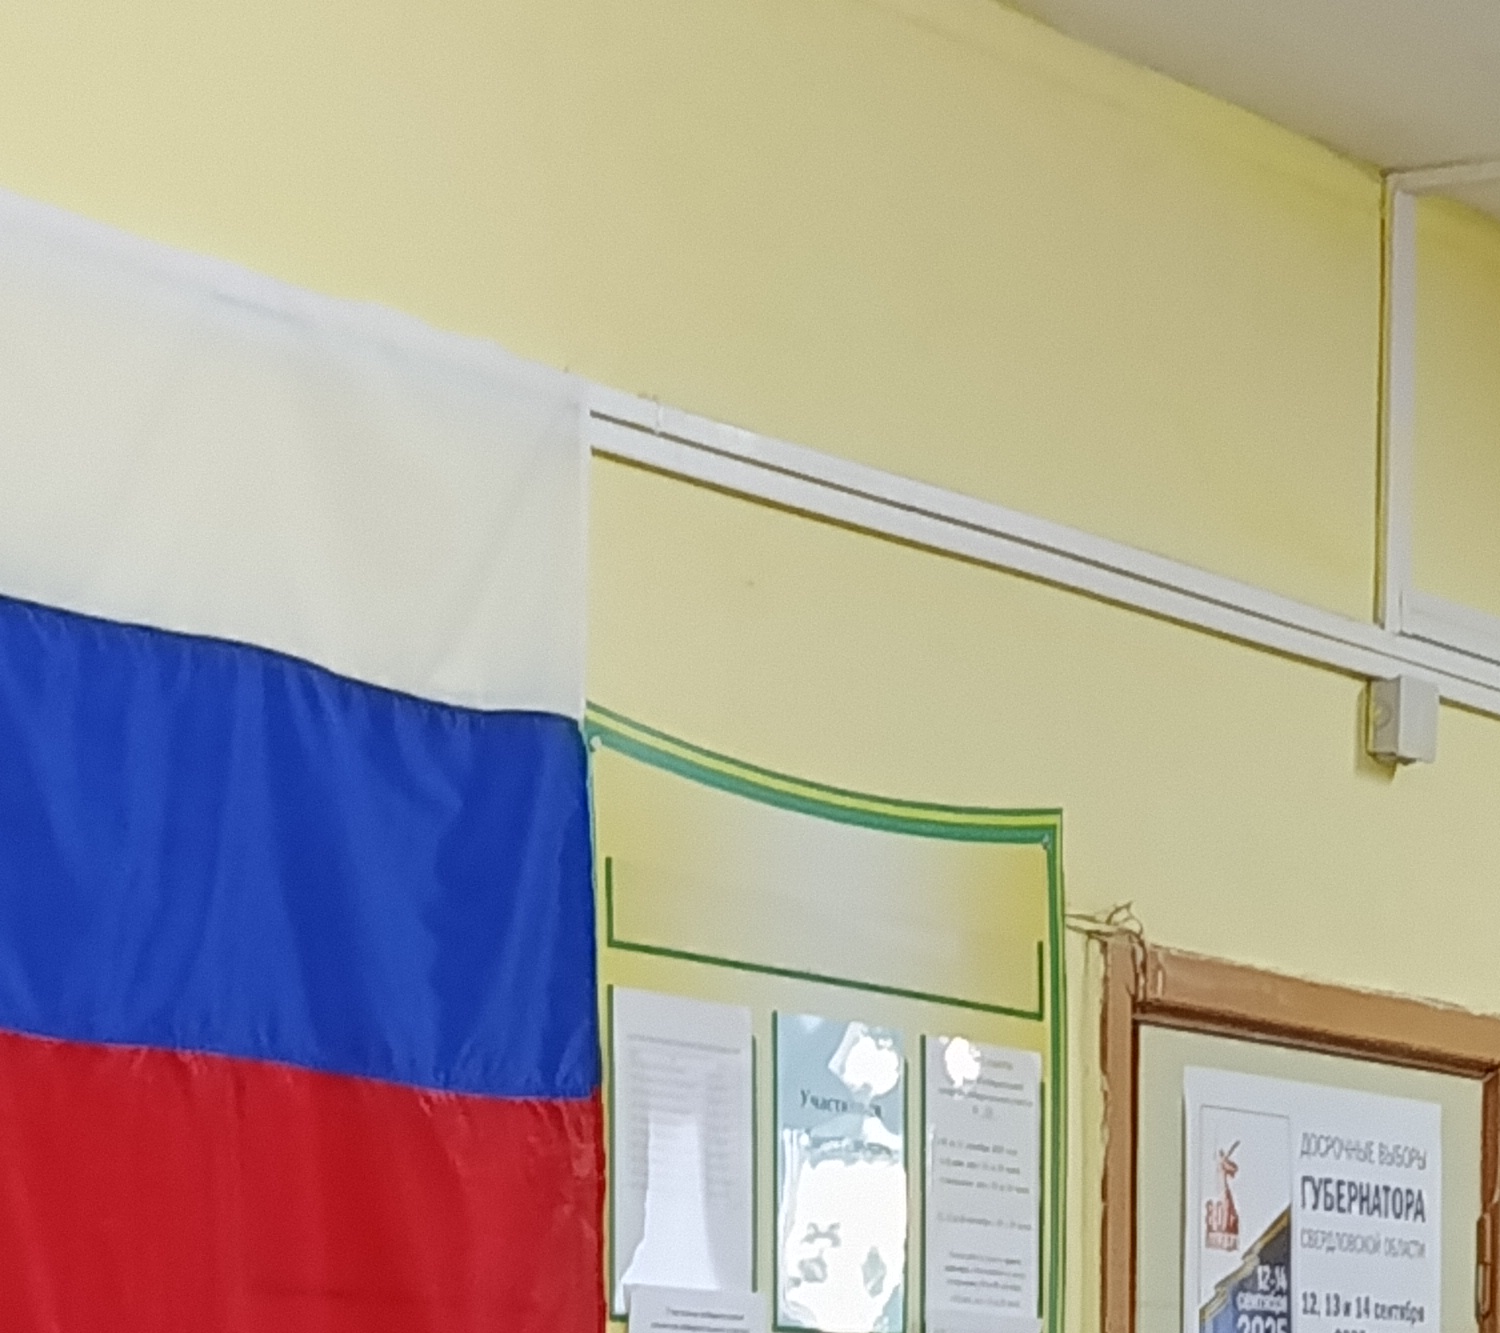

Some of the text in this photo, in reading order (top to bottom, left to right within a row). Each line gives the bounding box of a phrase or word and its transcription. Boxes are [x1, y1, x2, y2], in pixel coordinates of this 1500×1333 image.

[1301, 1133, 1428, 1171] ДОСРОЧНЫЕ ВЫБОРЫ
[1301, 1175, 1427, 1223] ГУБЕРНАТОРА
[1300, 1227, 1427, 1259] СВЕРДЛОВСКОЙ ОБЛАСТИ
[1301, 1291, 1425, 1325] 12, 13 и 14 сентября
